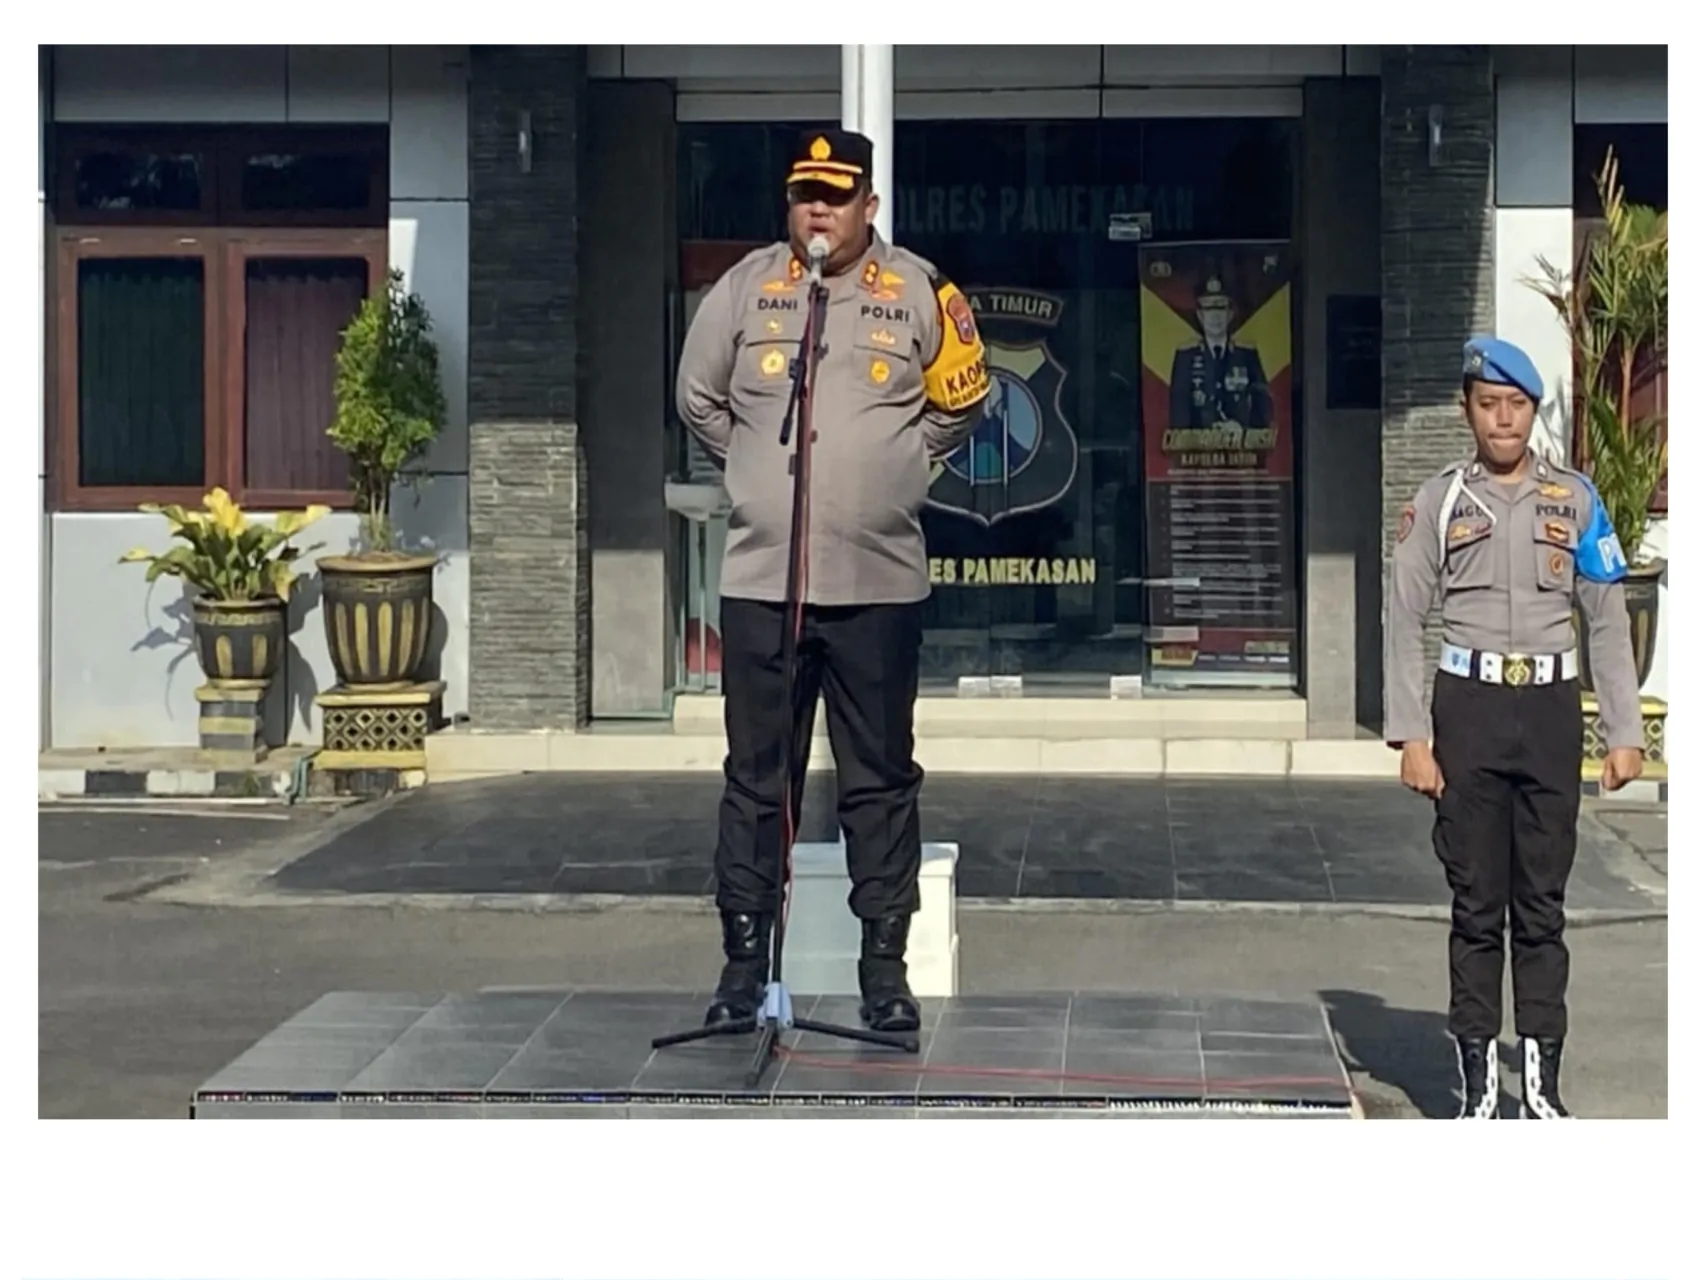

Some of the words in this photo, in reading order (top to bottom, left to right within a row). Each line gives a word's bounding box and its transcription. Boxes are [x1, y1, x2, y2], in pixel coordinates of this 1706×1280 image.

[757, 297, 798, 311] DANI
[860, 304, 910, 323] POLRI
[988, 293, 1054, 319] TIMUR
[1535, 503, 1577, 521] POLRI
[962, 557, 1096, 585] PAMEKASAN
